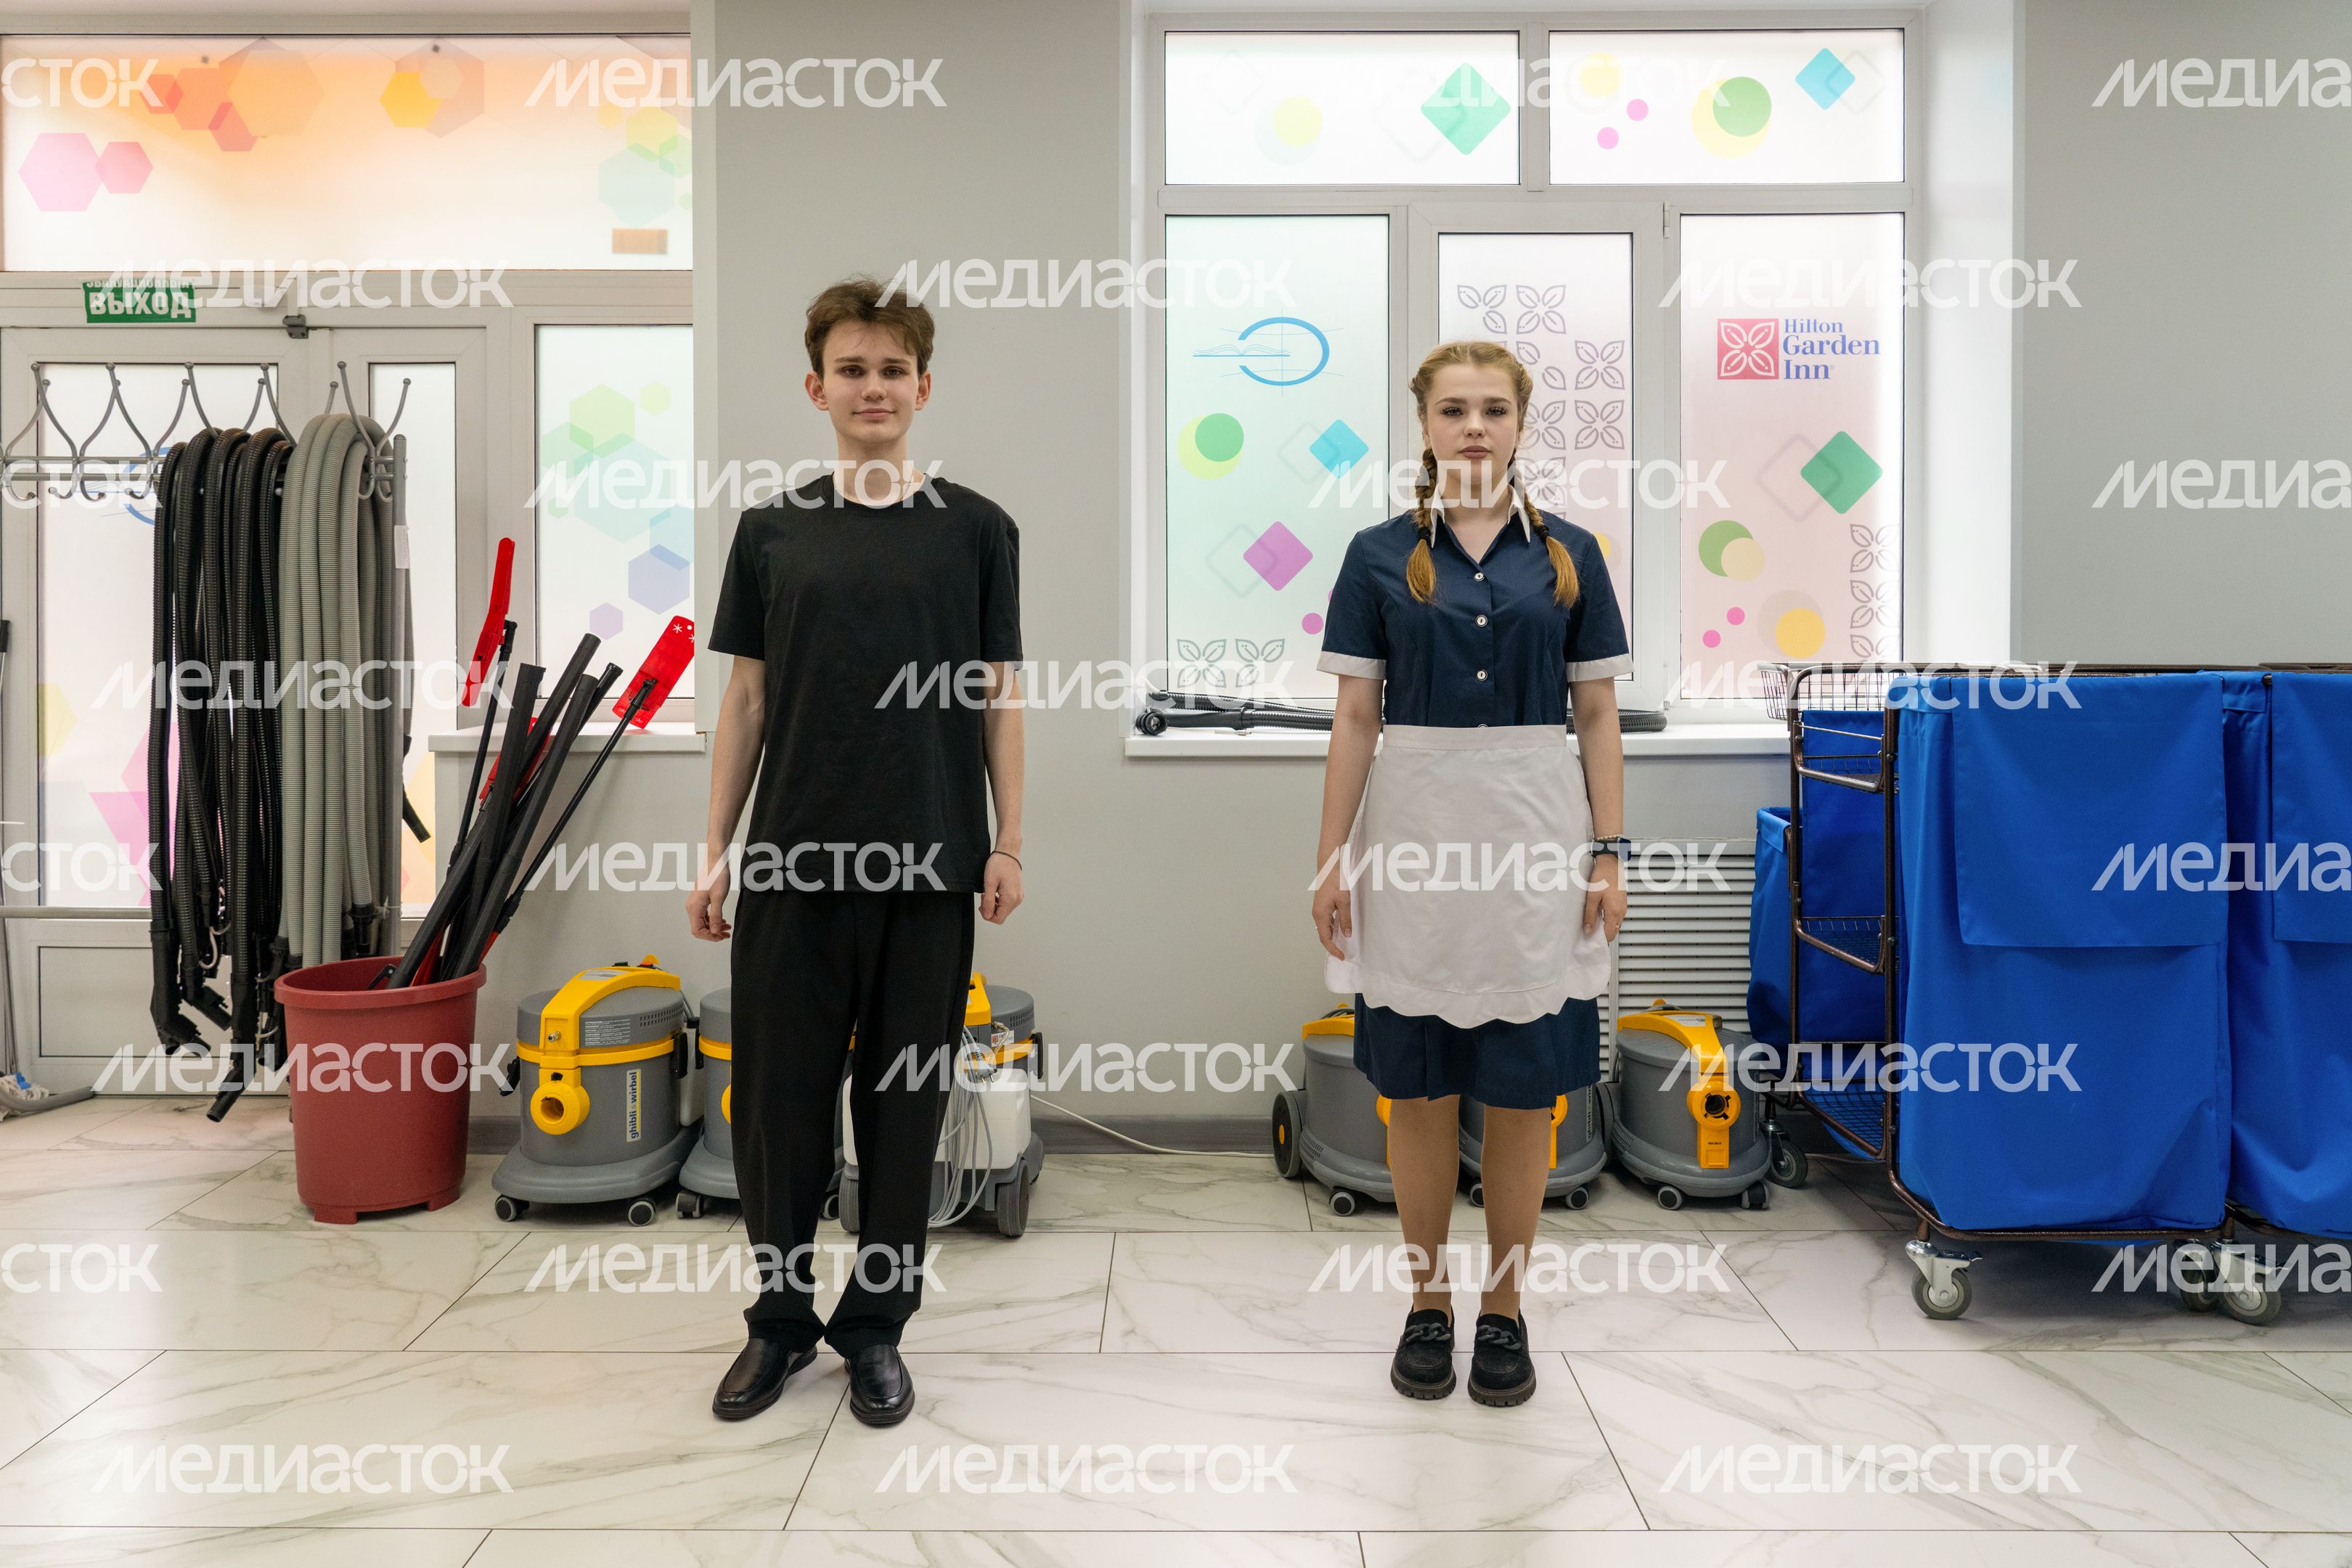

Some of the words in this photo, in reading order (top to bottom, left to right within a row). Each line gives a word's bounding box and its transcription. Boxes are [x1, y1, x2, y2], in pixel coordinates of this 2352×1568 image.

[89, 292, 191, 319] ВЫХОД
[1784, 319, 1843, 333] Hilton
[1783, 334, 1881, 356] Garden
[1784, 359, 1831, 380] Inn
[629, 1111, 639, 1139] ghibli
